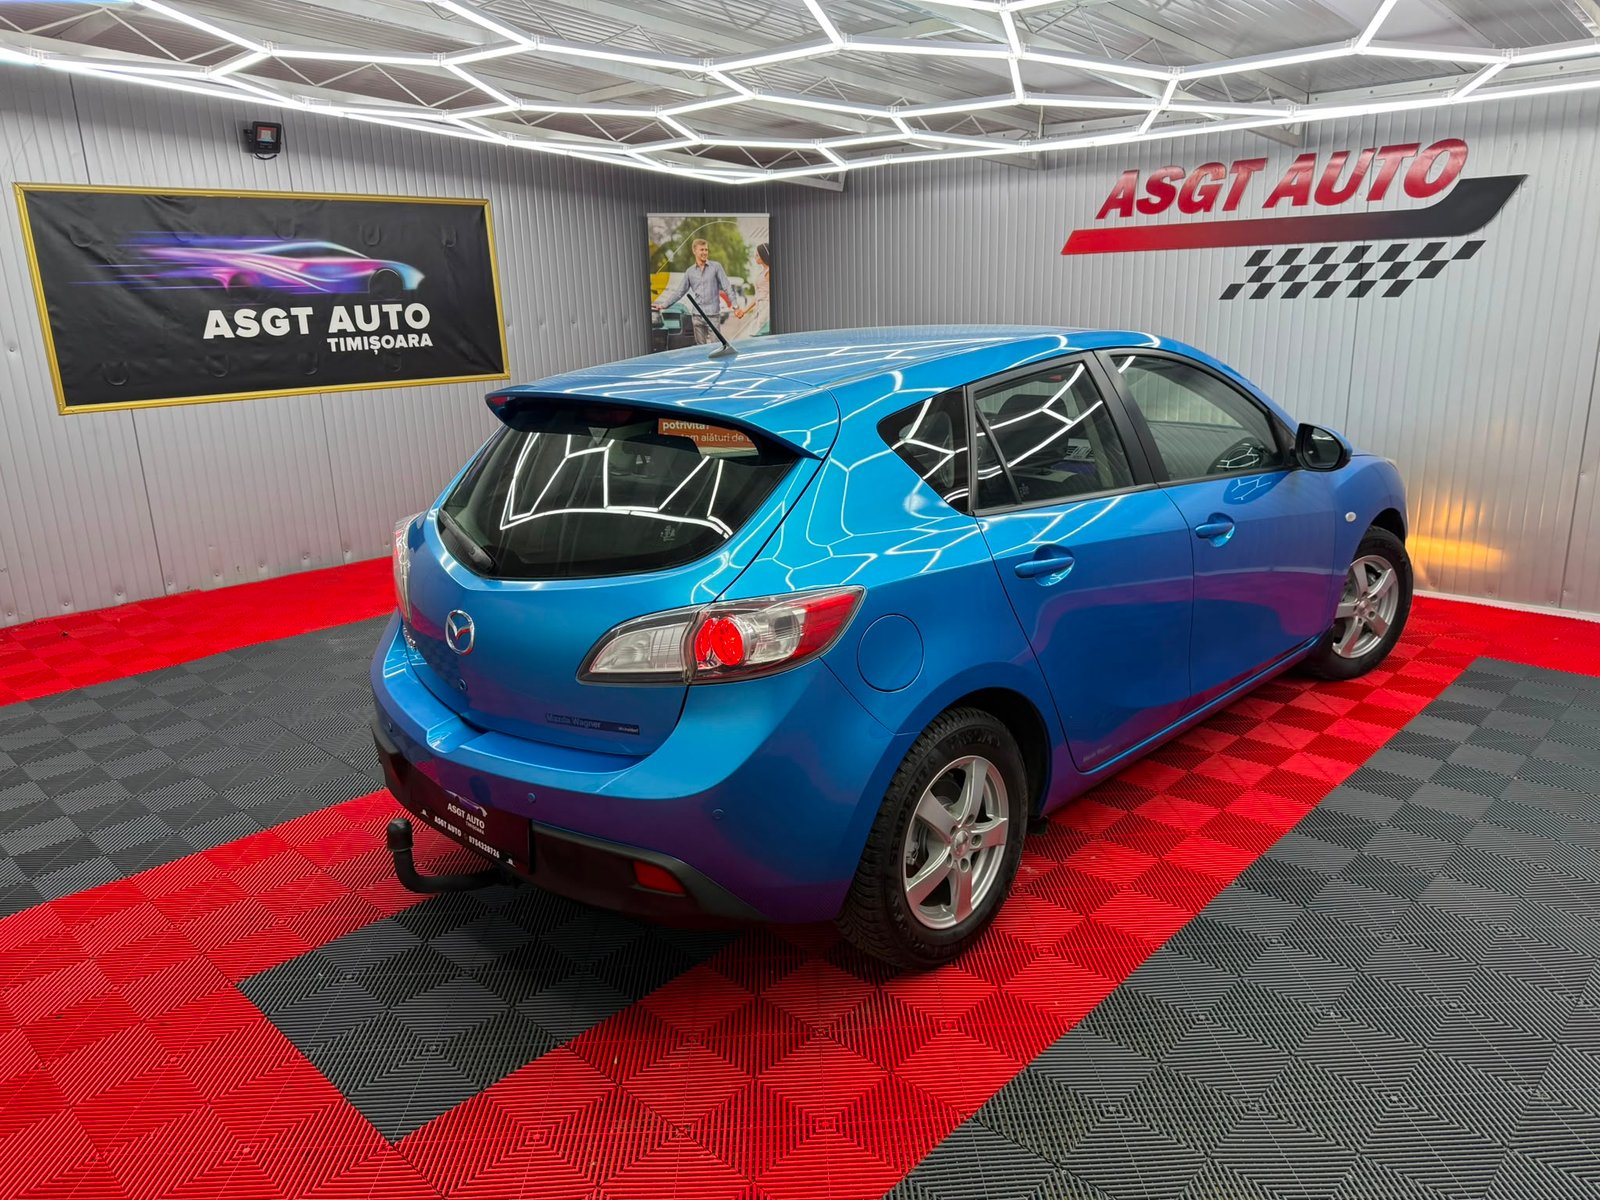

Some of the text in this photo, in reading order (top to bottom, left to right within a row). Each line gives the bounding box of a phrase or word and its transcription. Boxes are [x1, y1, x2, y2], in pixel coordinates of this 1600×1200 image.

[1096, 138, 1469, 219] ASGT AUTO
[203, 303, 431, 339] ASGT AUTO
[326, 333, 434, 355] TIMIȘOARA
[701, 432, 730, 442] alături
[731, 433, 744, 442] de
[447, 803, 485, 828] ASGT AUTO
